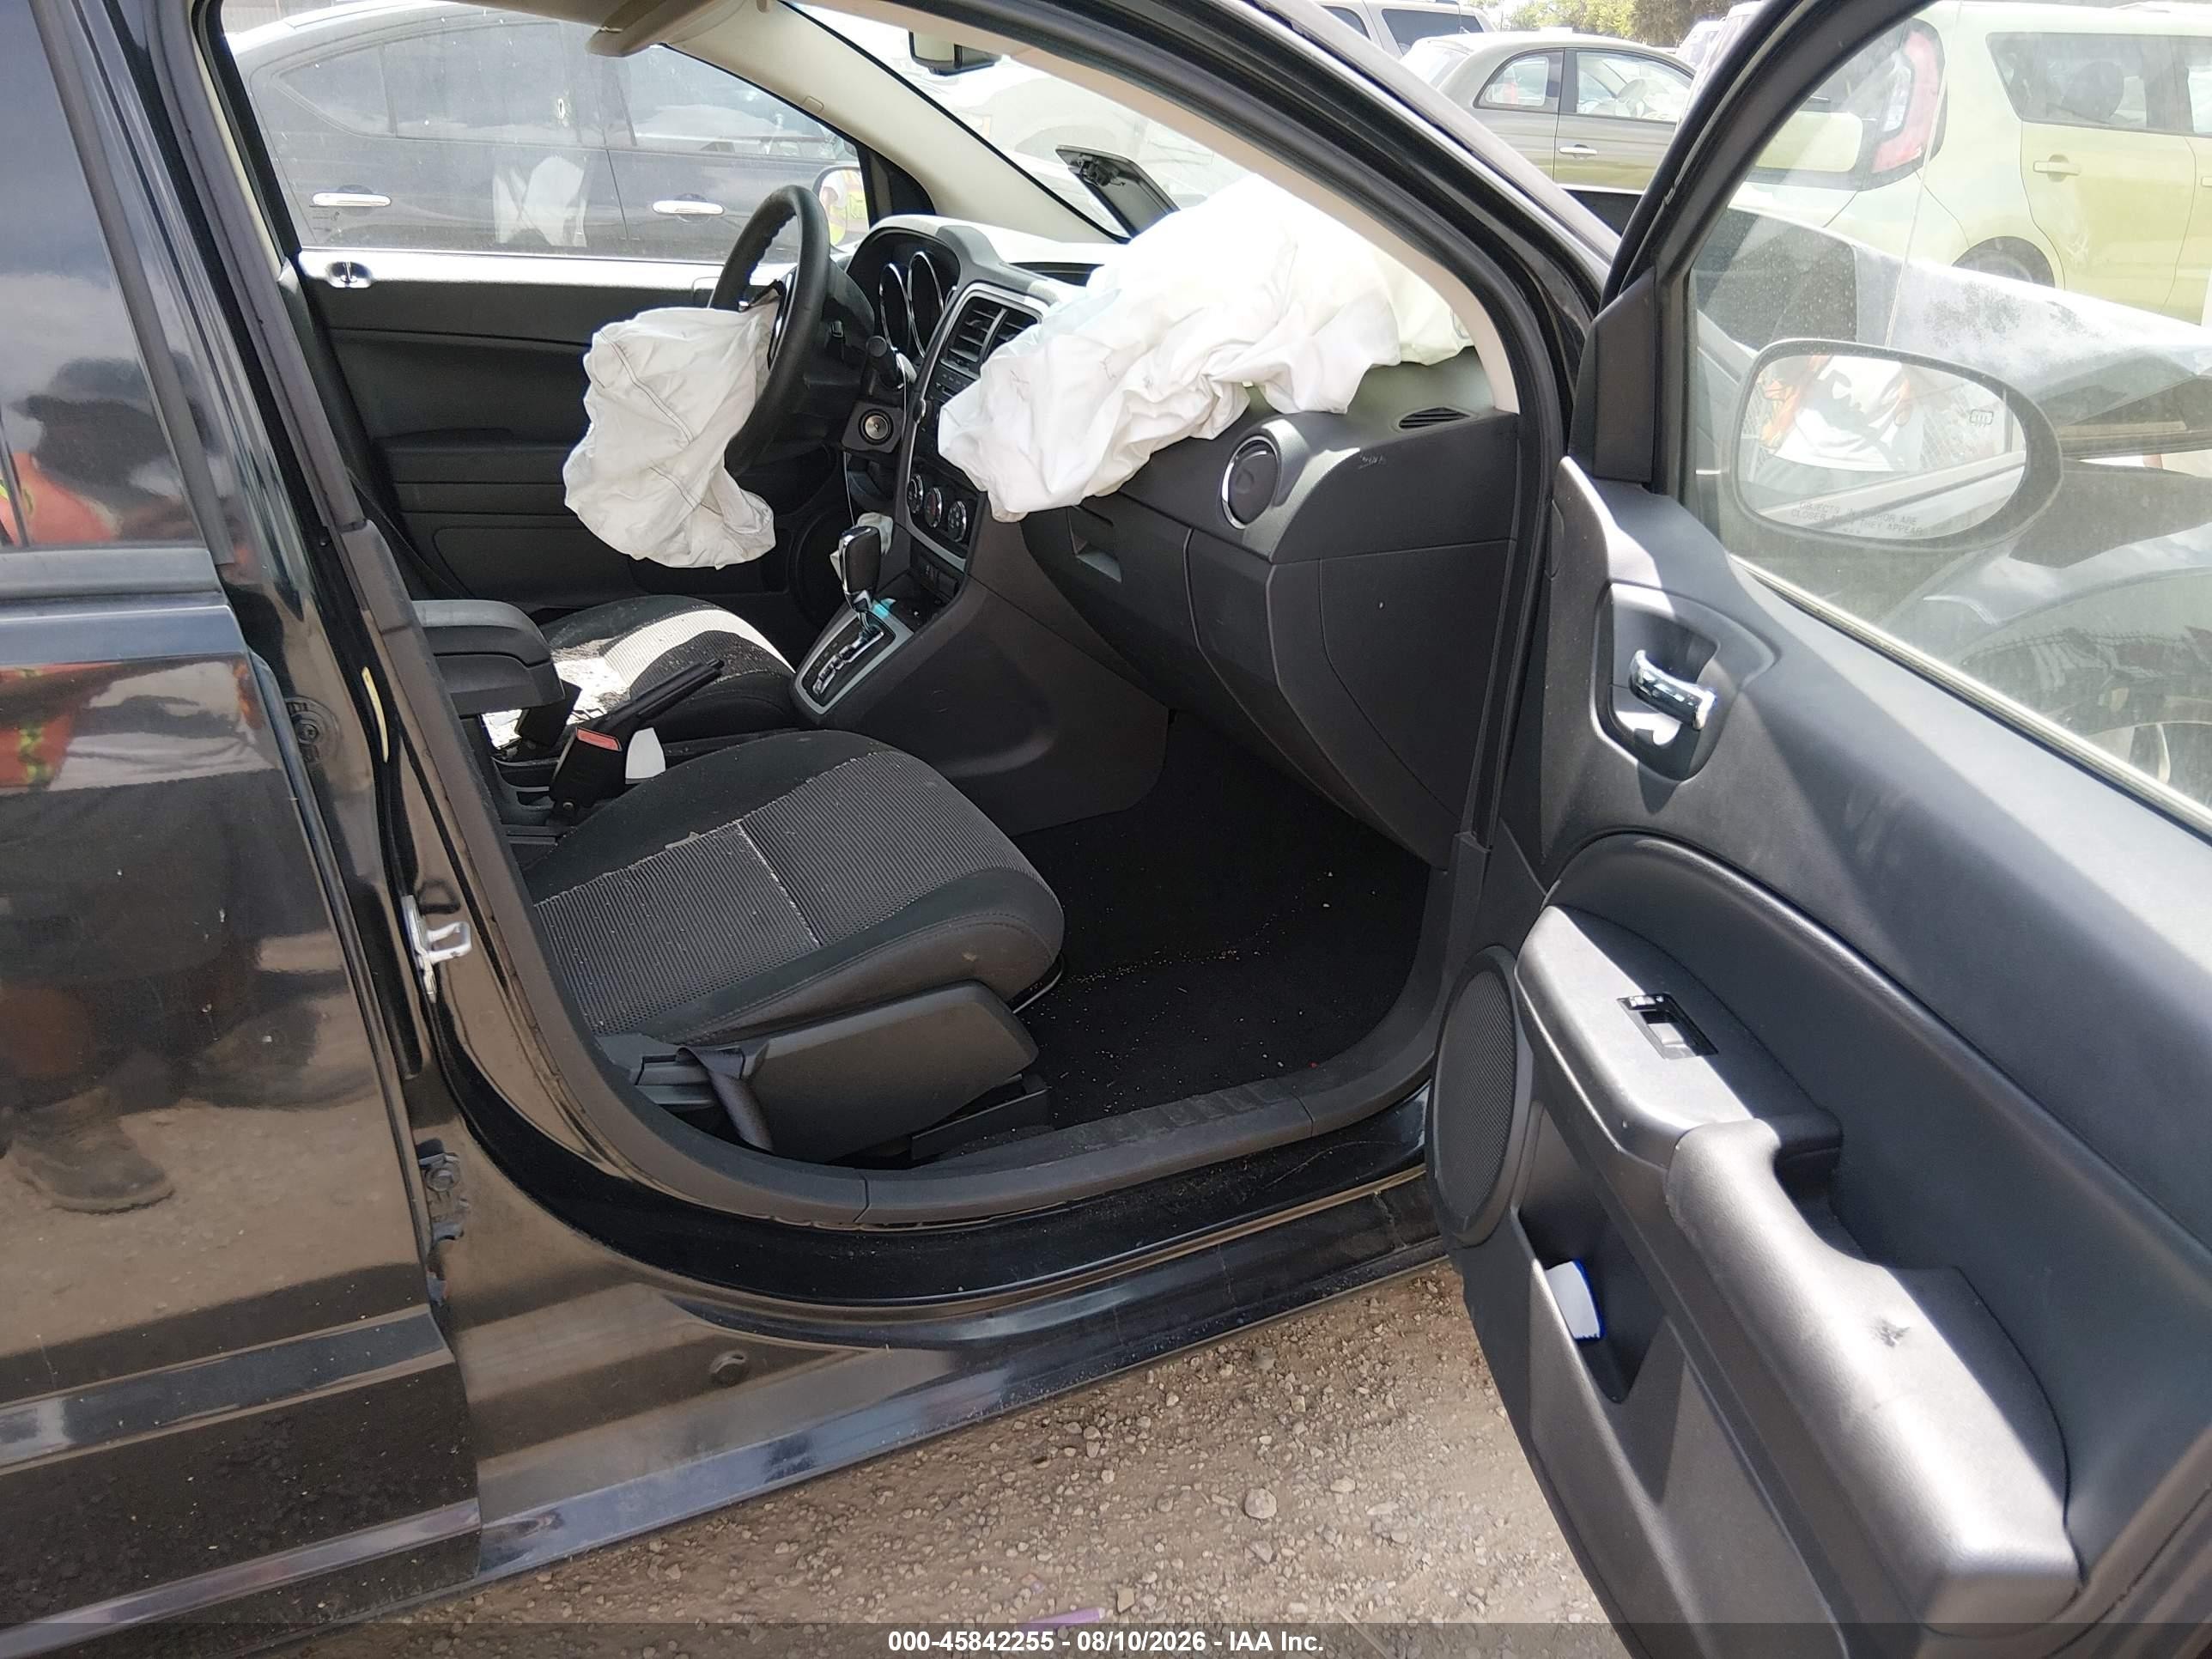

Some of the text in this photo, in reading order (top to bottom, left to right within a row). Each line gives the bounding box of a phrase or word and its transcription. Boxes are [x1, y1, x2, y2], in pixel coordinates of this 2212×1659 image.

[1791, 508, 1826, 521] CLOSER
[1887, 523, 1924, 537] APPEAR
[1800, 501, 1840, 514] OBJECTS
[1901, 516, 1917, 526] ARE
